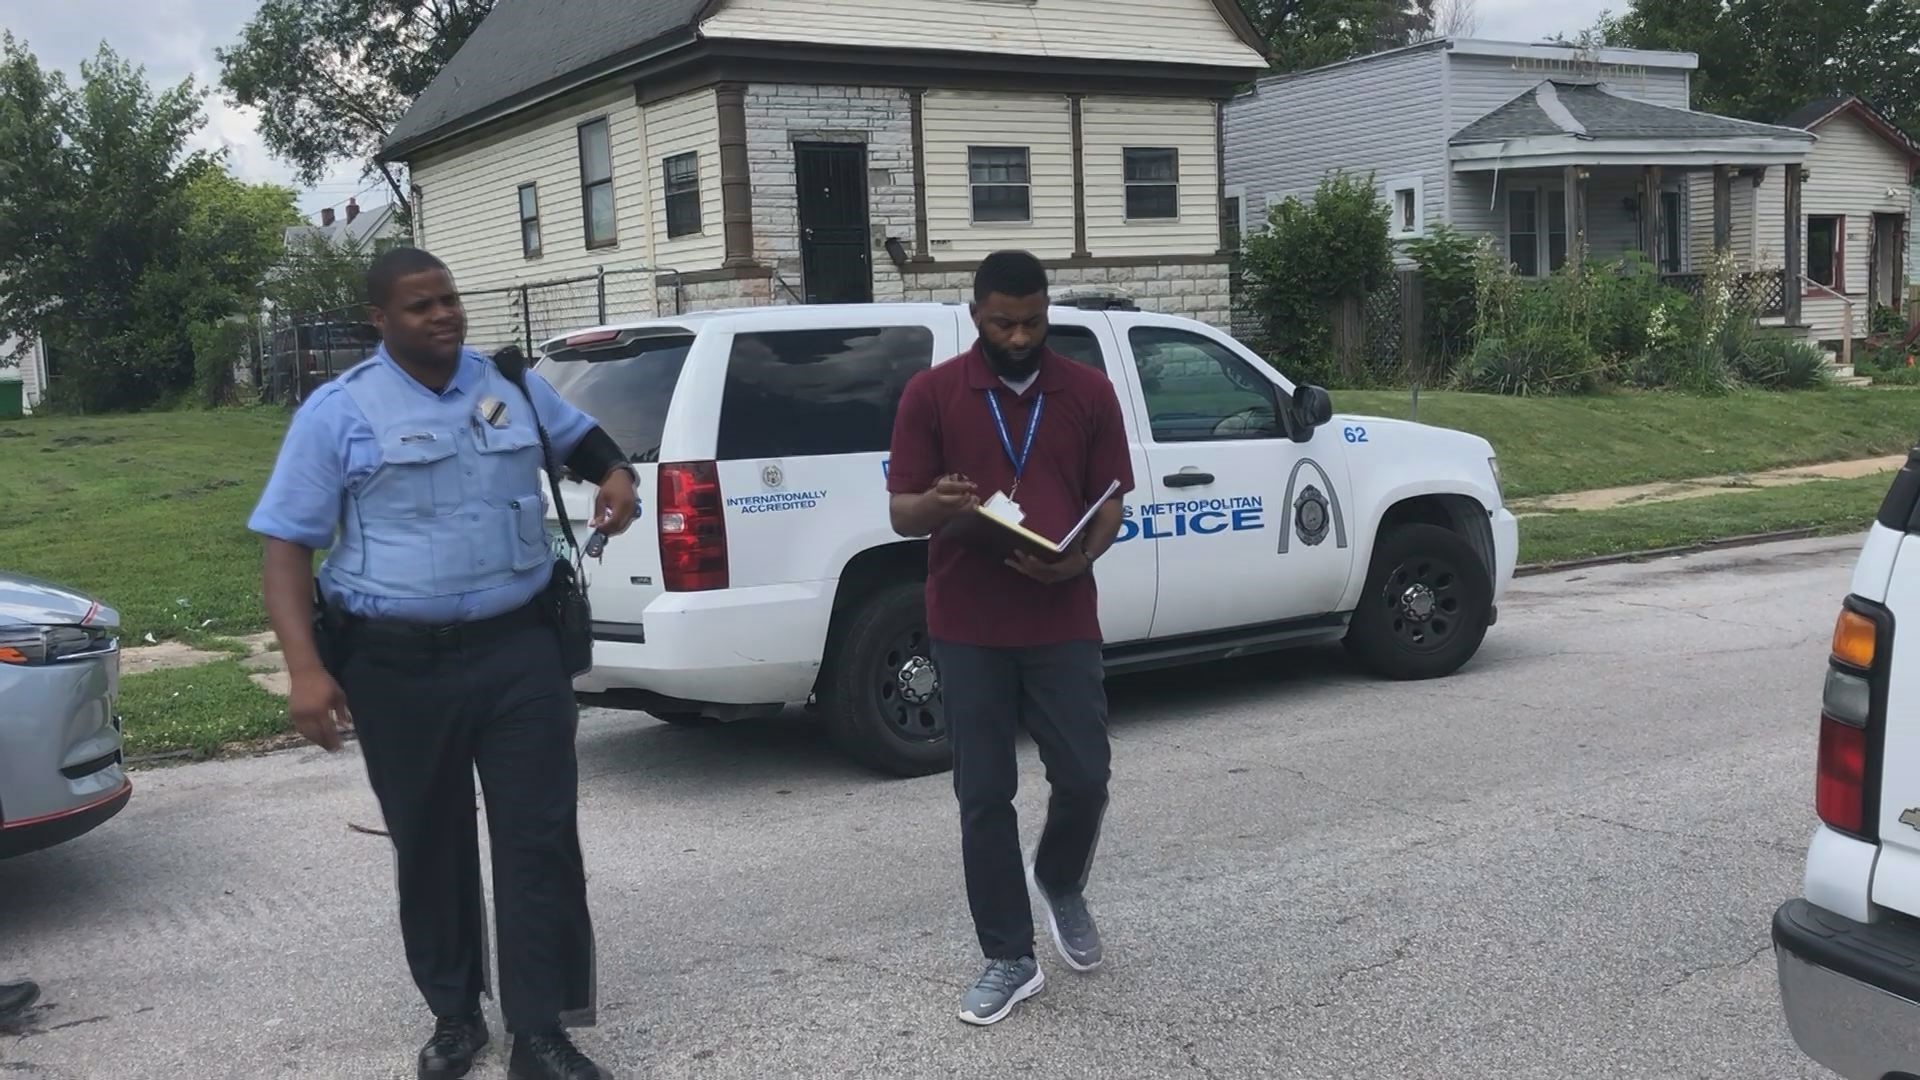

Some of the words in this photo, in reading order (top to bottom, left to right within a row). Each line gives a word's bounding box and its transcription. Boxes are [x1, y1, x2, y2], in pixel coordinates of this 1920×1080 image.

[1343, 426, 1369, 443] 62
[726, 490, 828, 507] INTERNATIONALLY
[741, 500, 817, 514] ACCREDITED
[1140, 496, 1263, 516] METROPOLITAN
[1113, 508, 1265, 544] OLICE
